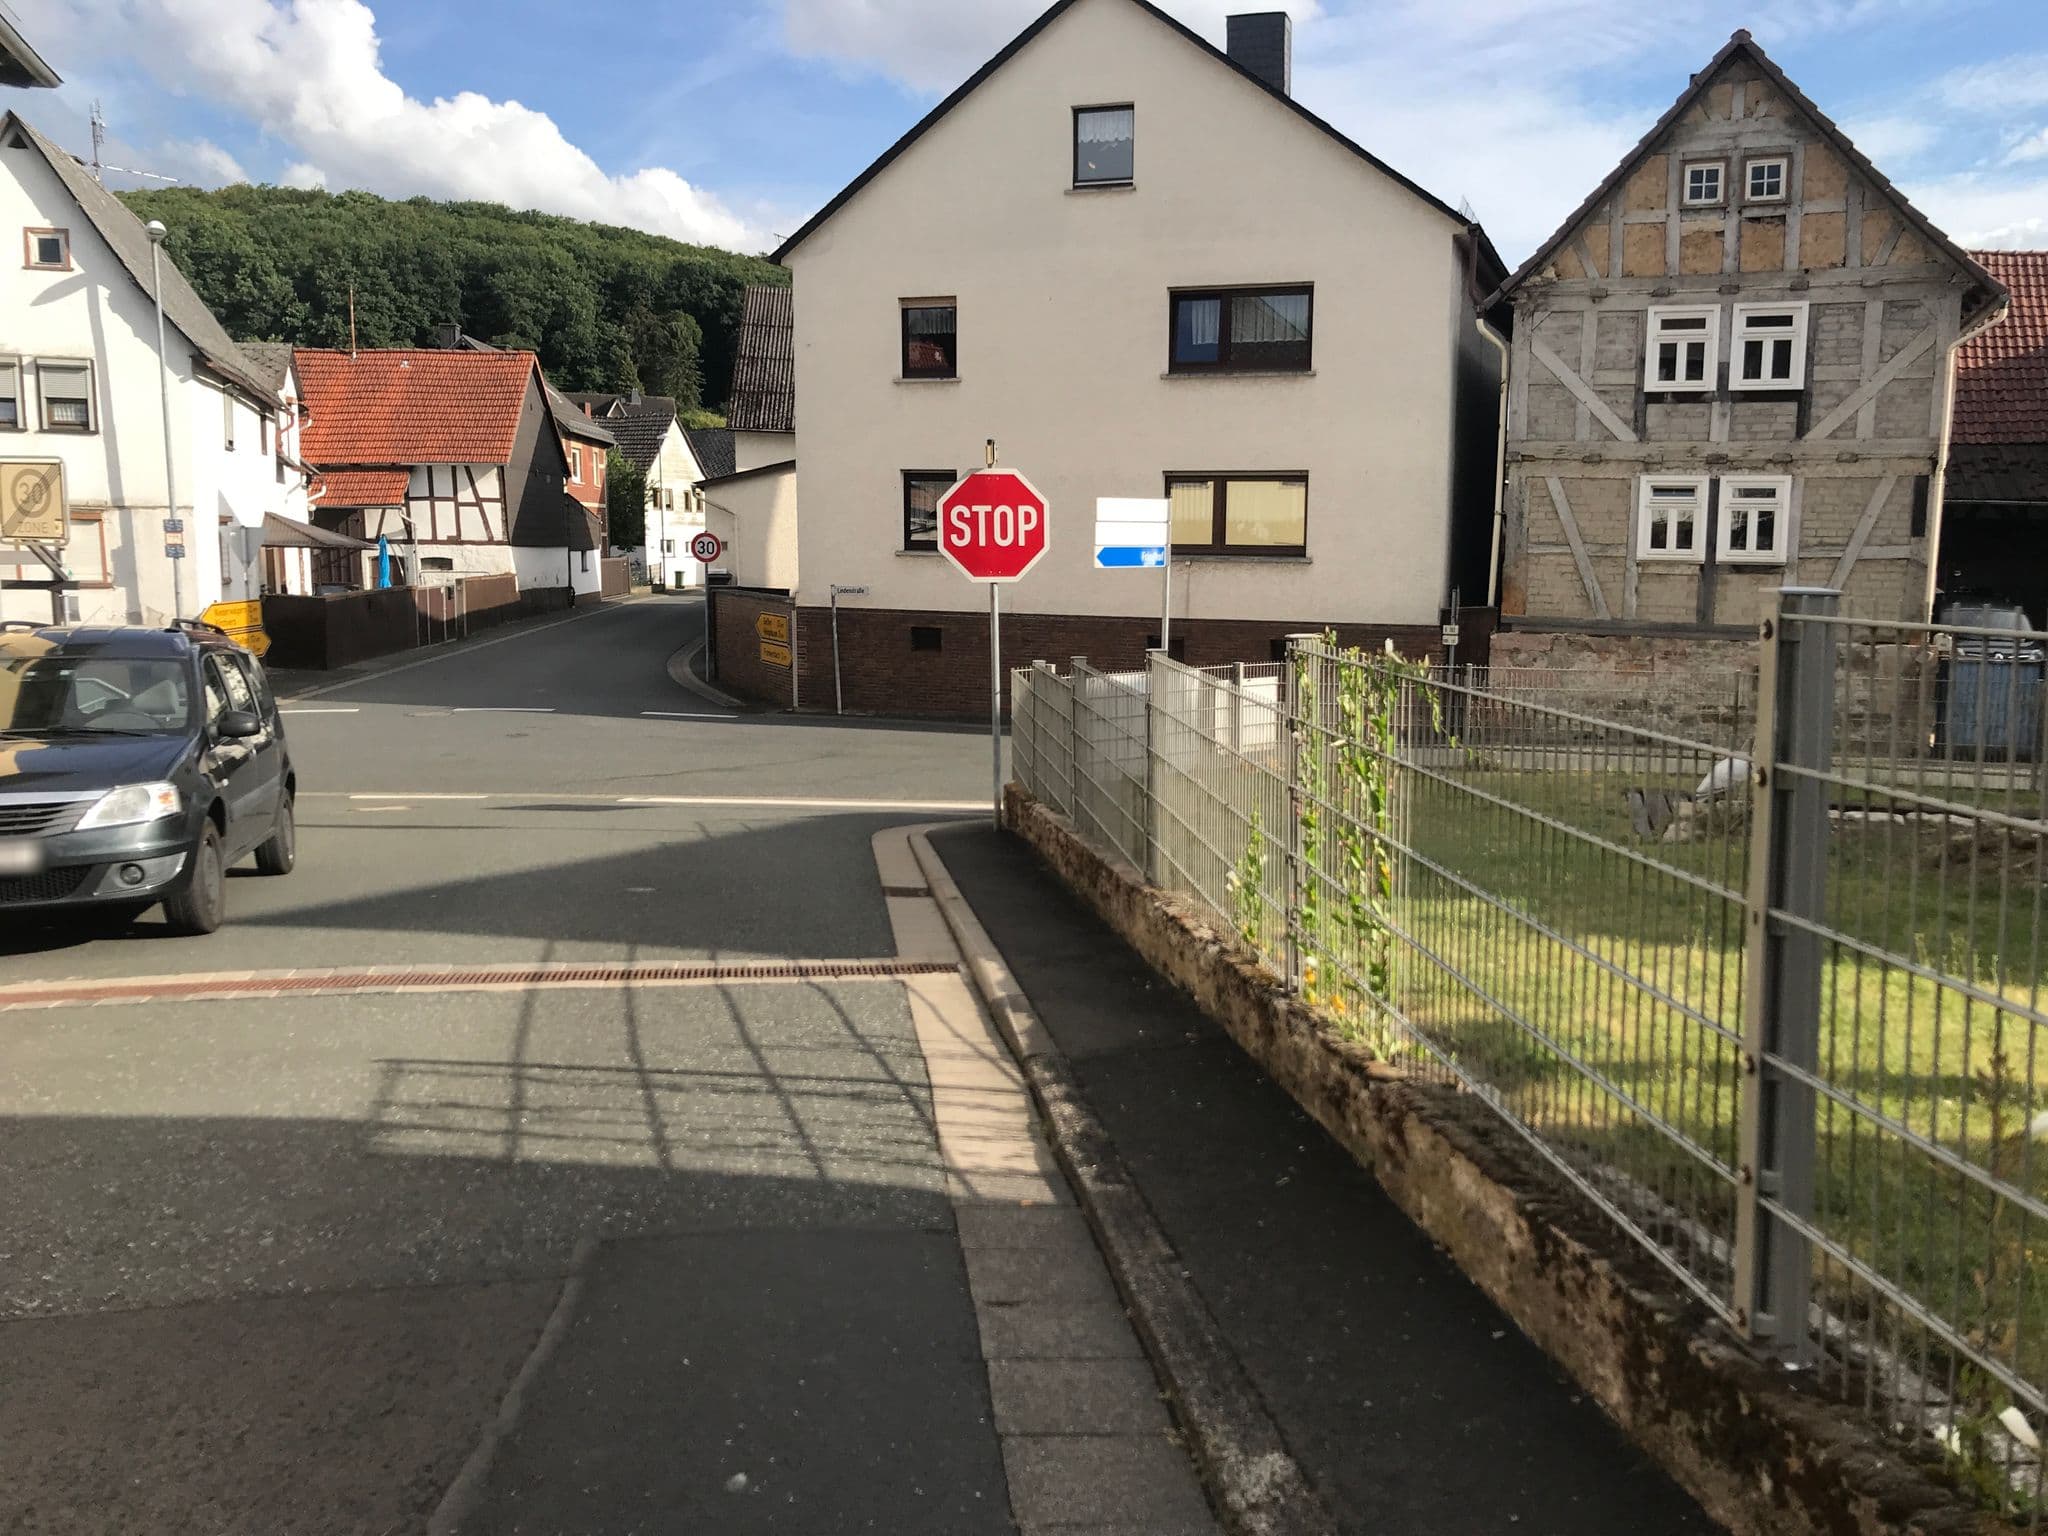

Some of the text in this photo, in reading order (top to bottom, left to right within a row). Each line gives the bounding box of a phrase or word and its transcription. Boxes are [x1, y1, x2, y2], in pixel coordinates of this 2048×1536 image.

[19, 482, 43, 504] 30
[17, 521, 49, 533] ZONE
[950, 505, 1038, 547] STOP
[697, 541, 715, 555] 30
